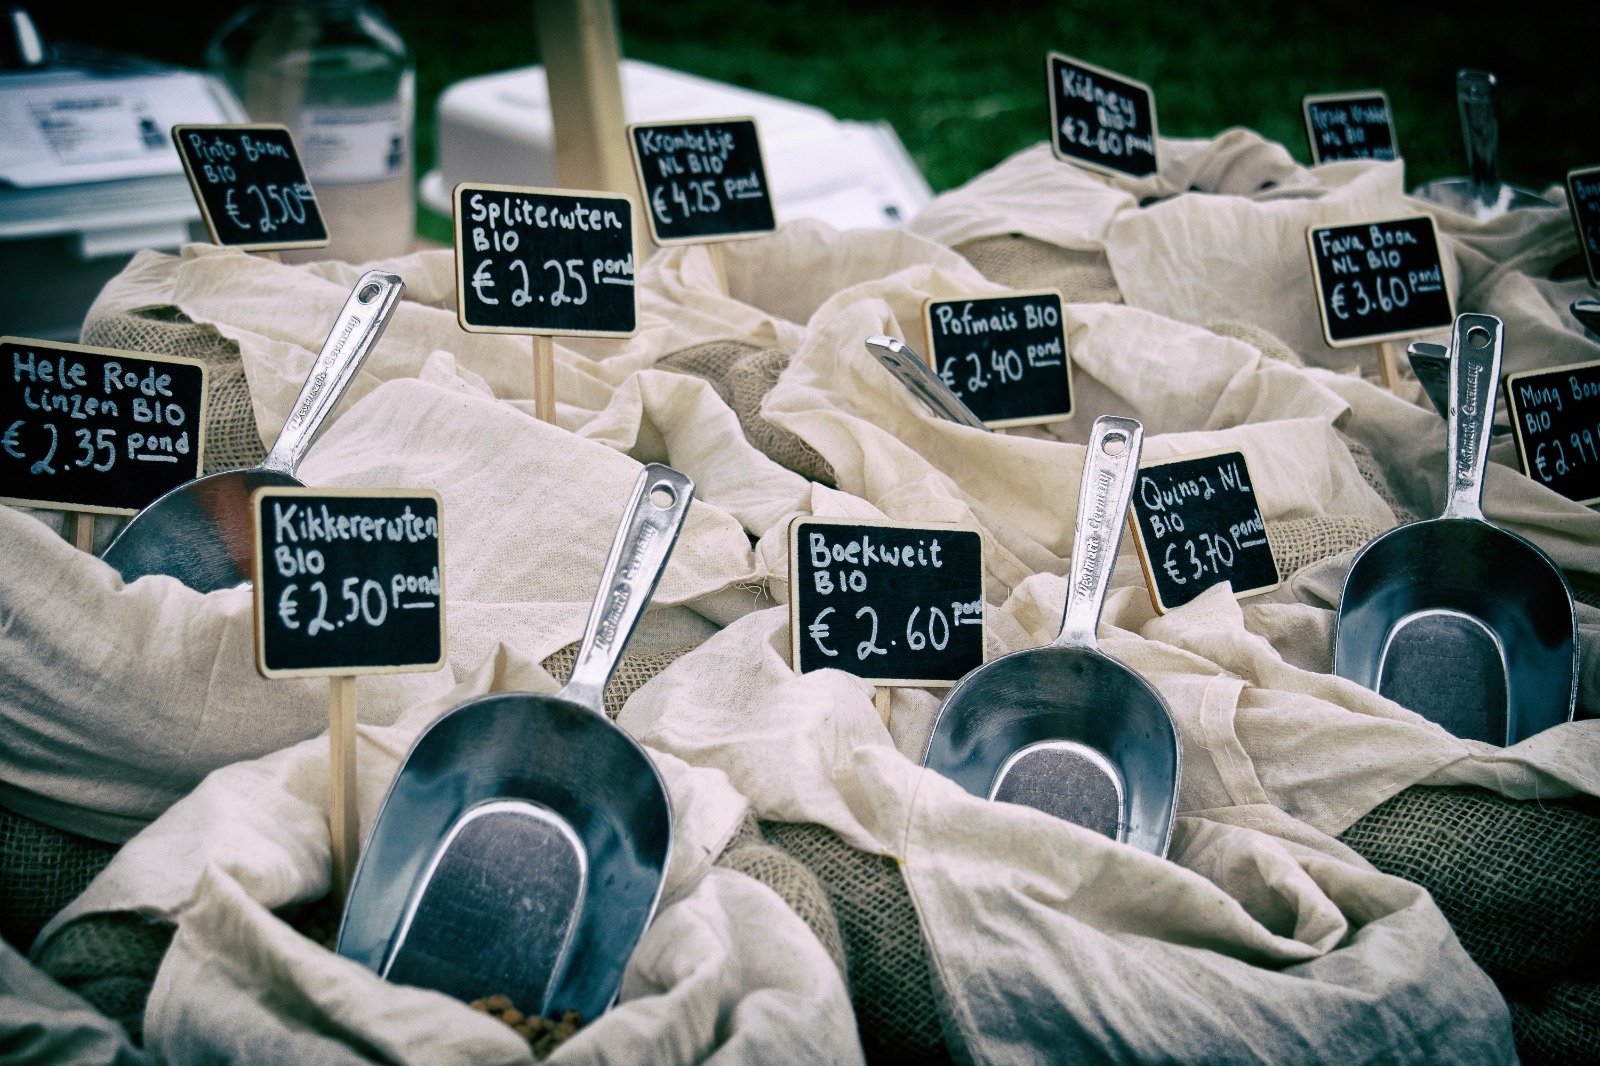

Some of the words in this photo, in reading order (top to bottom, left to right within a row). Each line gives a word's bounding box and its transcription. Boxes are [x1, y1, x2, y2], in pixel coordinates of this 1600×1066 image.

[1061, 68, 1136, 129] Kidney
[189, 133, 237, 162] Pinto
[242, 135, 290, 162] Boon
[639, 127, 735, 161] Krombekje
[203, 164, 237, 183] BIO
[657, 155, 684, 178] NL
[687, 153, 724, 175] BIO
[470, 194, 622, 231] Spliterwten
[472, 227, 519, 252] BIO
[1318, 230, 1365, 257] Fava
[1369, 225, 1417, 248] Boon
[1332, 255, 1360, 275] NL
[1366, 250, 1401, 270] BIO
[1408, 263, 1441, 293] pond
[936, 302, 1018, 335] Pofmais
[1024, 304, 1058, 330] BIO
[1027, 336, 1062, 367] pond
[13, 352, 87, 389] Hele
[104, 361, 173, 397] Rode
[24, 386, 119, 420] Linzen
[133, 398, 185, 426] BIO
[1520, 384, 1563, 412] Mung
[1569, 375, 1600, 400] Boo
[1525, 410, 1550, 435] BIO
[127, 431, 190, 464] pond
[1141, 476, 1215, 512] Quinoa
[1217, 461, 1250, 492] NL
[274, 502, 439, 543] Kikkererwten
[1150, 512, 1185, 539] BIO
[1229, 508, 1267, 550] pond
[274, 545, 325, 577] BIO
[809, 532, 943, 568] Boekweit
[392, 566, 440, 609] pond
[814, 569, 868, 595] BIO
